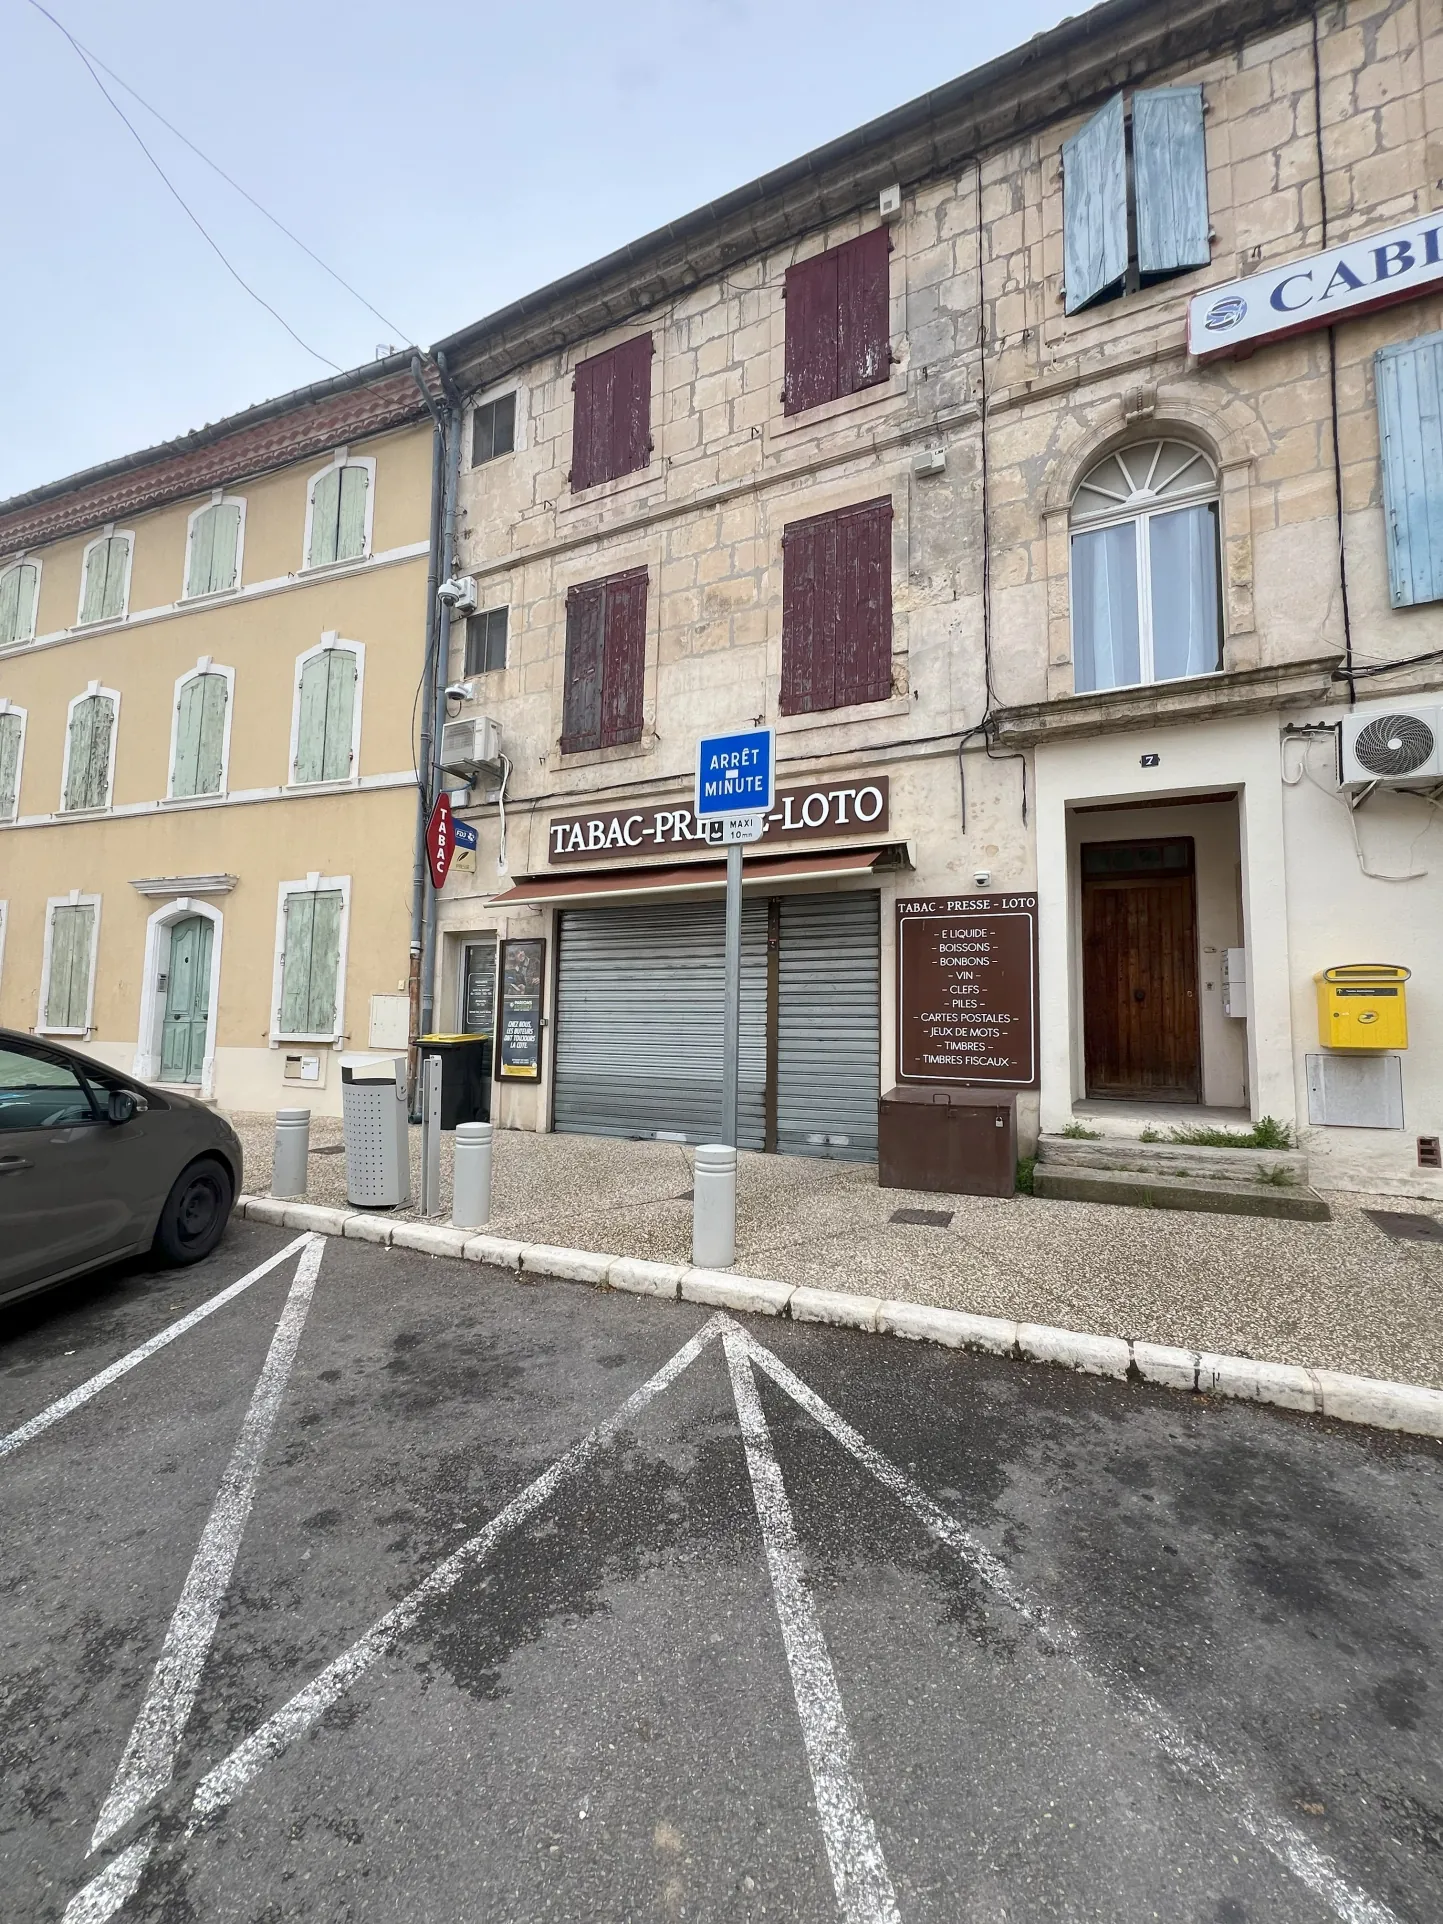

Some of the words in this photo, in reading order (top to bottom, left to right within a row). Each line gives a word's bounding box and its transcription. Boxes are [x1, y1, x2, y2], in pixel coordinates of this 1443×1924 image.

[710, 747, 760, 771] ARRÊT
[1145, 756, 1154, 766] 7
[705, 775, 763, 797] MINUTE
[729, 818, 753, 829] MAXI
[456, 830, 467, 838] FDJ
[730, 830, 753, 839] 10mn
[436, 808, 448, 873] TABAC
[897, 902, 936, 913] TABAC
[946, 899, 991, 911] PRESSE
[1001, 897, 1036, 909] LOTO
[941, 929, 948, 939] E
[949, 928, 988, 939] LIQUIDE
[939, 942, 991, 953] BOISSONS
[939, 956, 990, 967] BONBONS
[955, 971, 974, 980] VIN
[949, 985, 980, 994] CLEFS
[952, 999, 978, 1009] PILES
[920, 1012, 958, 1022] CARTES
[960, 1013, 1011, 1024] POSTALES
[929, 1026, 953, 1038] JEUX
[955, 1027, 967, 1037] DE
[969, 1027, 1000, 1038] MOTS
[944, 1041, 986, 1052] TIMBRES
[922, 1054, 963, 1065] TIMBRES
[965, 1056, 1010, 1067] FISCAUX
